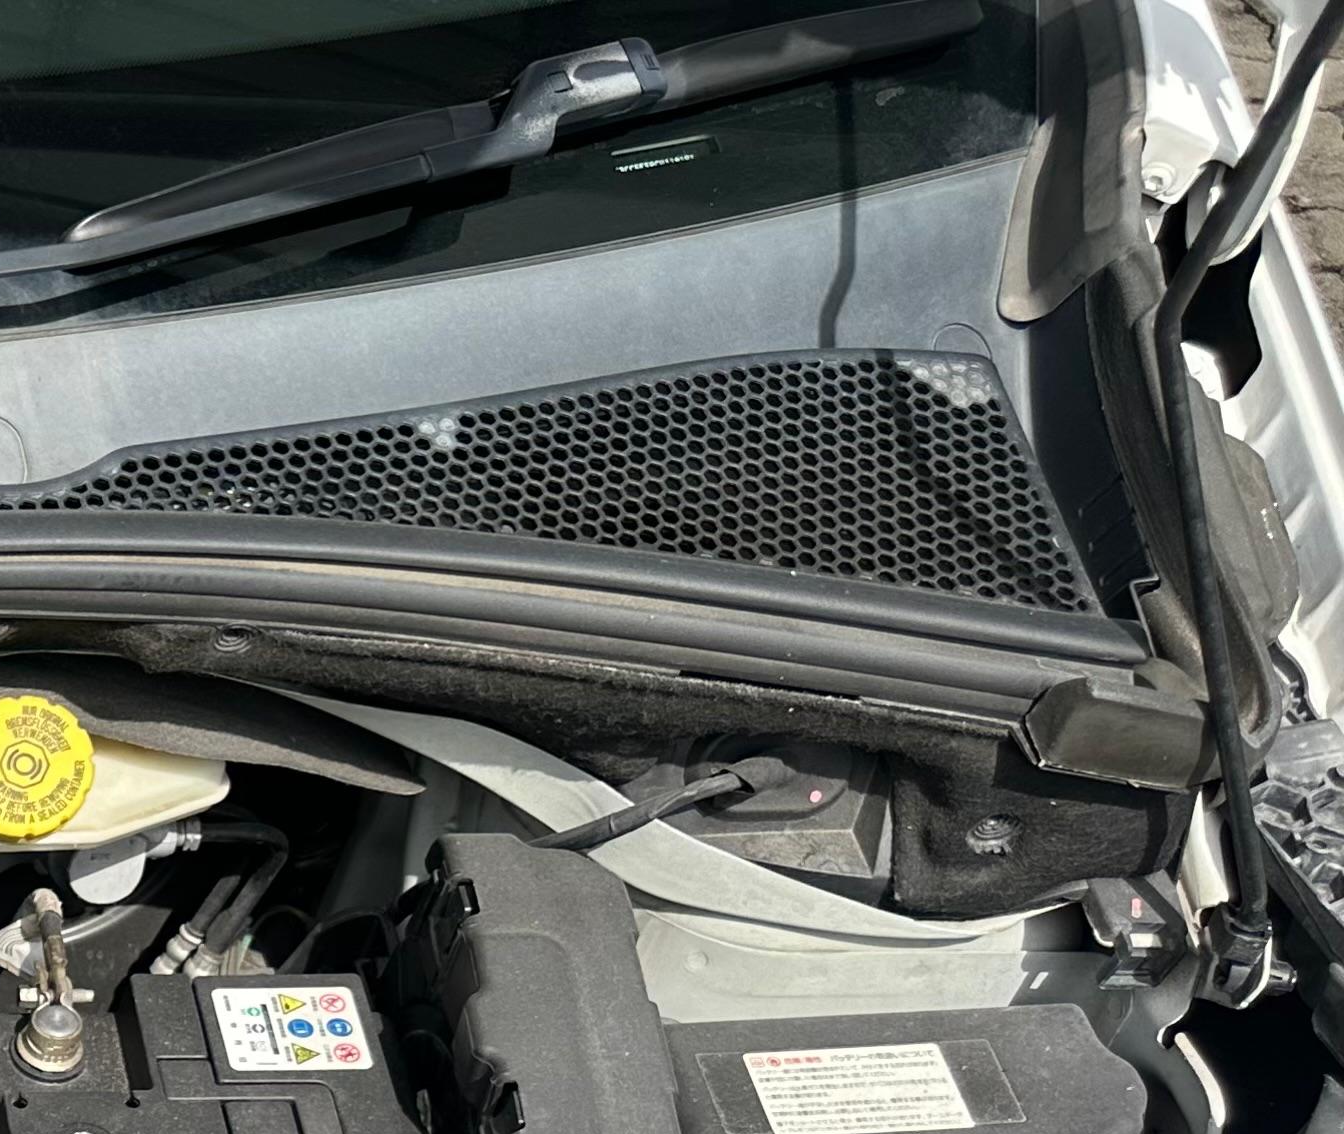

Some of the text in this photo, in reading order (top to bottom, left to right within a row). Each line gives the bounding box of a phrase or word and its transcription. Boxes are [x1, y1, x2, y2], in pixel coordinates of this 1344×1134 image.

[3, 812, 26, 824] FROM
[29, 814, 35, 824] A
[38, 801, 68, 822] SEALED
[64, 760, 85, 801] CONTAINER
